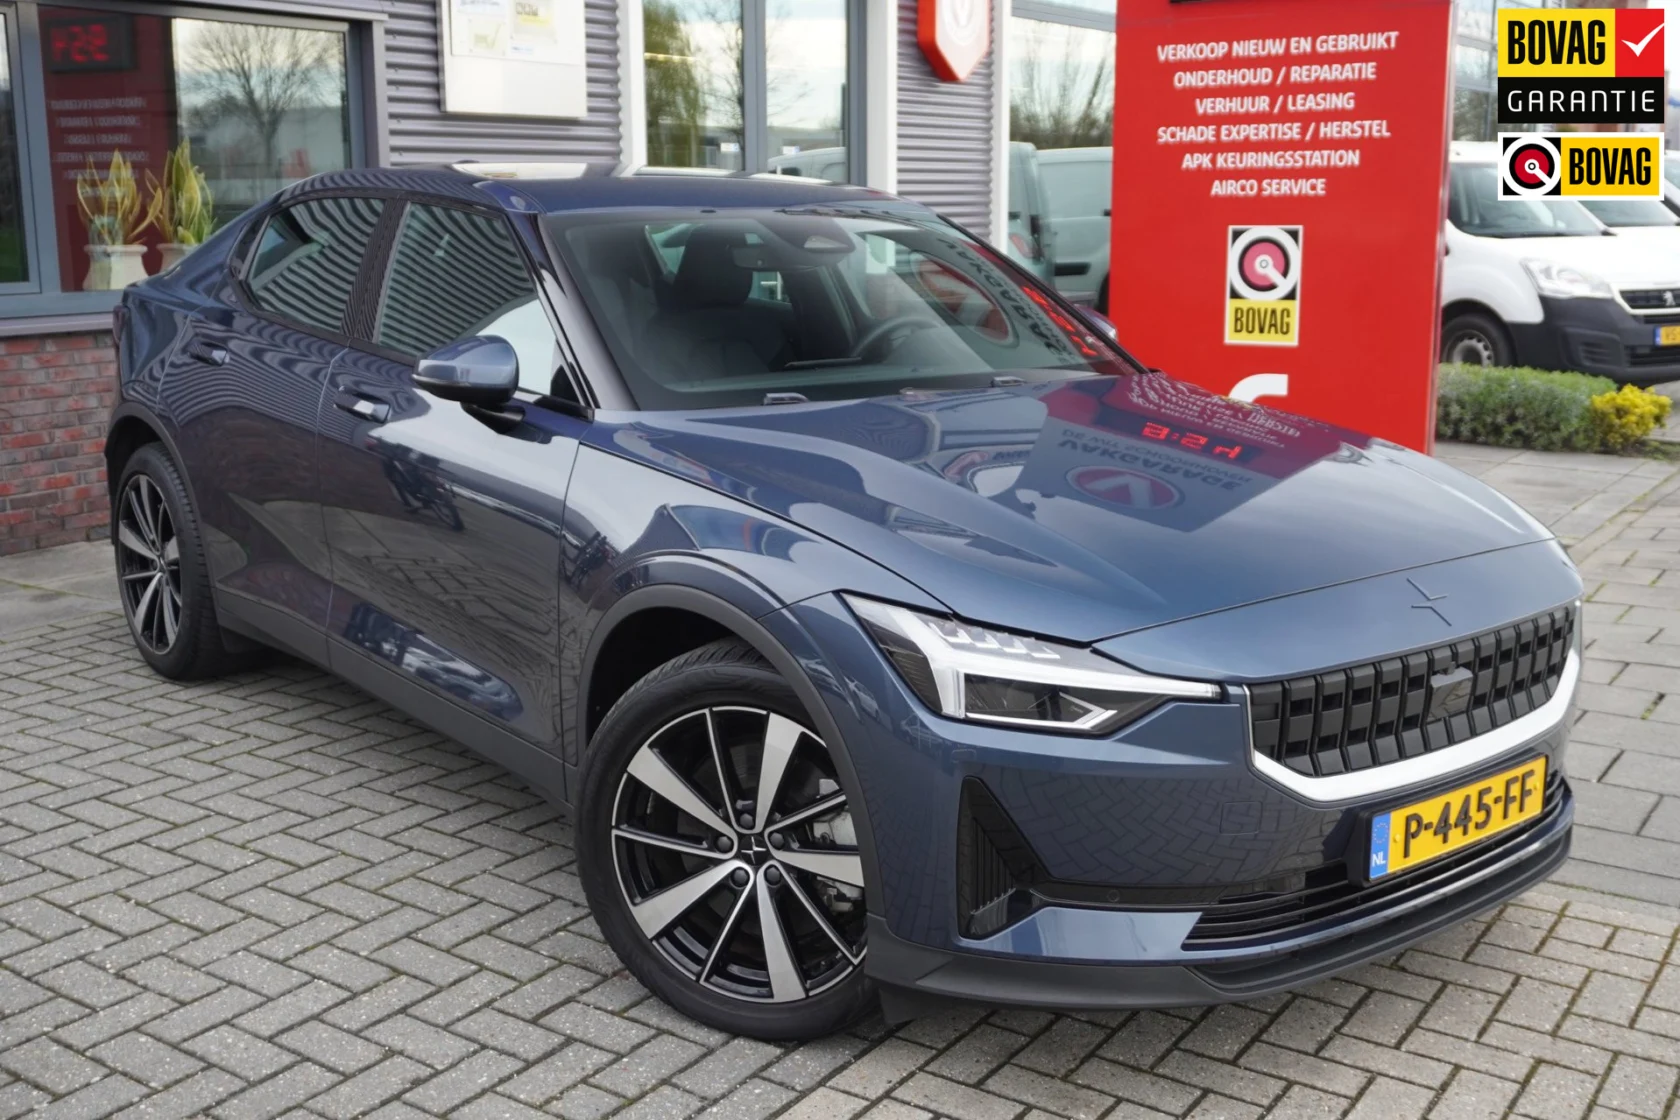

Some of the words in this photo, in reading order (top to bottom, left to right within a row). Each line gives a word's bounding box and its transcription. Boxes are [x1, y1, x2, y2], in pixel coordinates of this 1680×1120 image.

[1157, 42, 1228, 62] VERKOOP
[1232, 38, 1286, 58] NIEUW
[1290, 36, 1312, 54] EN
[1315, 31, 1399, 52] GEBRUIKT
[1174, 67, 1273, 88] ONDERHOUD
[1276, 67, 1286, 85] /
[1290, 62, 1377, 82] REPARATIE
[1195, 96, 1269, 115] VERHUUR
[1273, 95, 1284, 114] /
[1287, 92, 1355, 112] LEASING
[1157, 125, 1216, 144] SCHADE
[1220, 123, 1301, 142] EXPERTISE
[1305, 122, 1316, 141] /
[1319, 120, 1391, 138] HERSTEL
[1181, 152, 1212, 170] APK
[1216, 149, 1360, 169] KEURINGSSTATION
[1210, 179, 1258, 196] AIRCO
[1261, 178, 1326, 195] SERVICE
[1234, 307, 1291, 335] BOVAG
[1403, 769, 1535, 859] P-445-FF
[1372, 851, 1386, 867] NL
